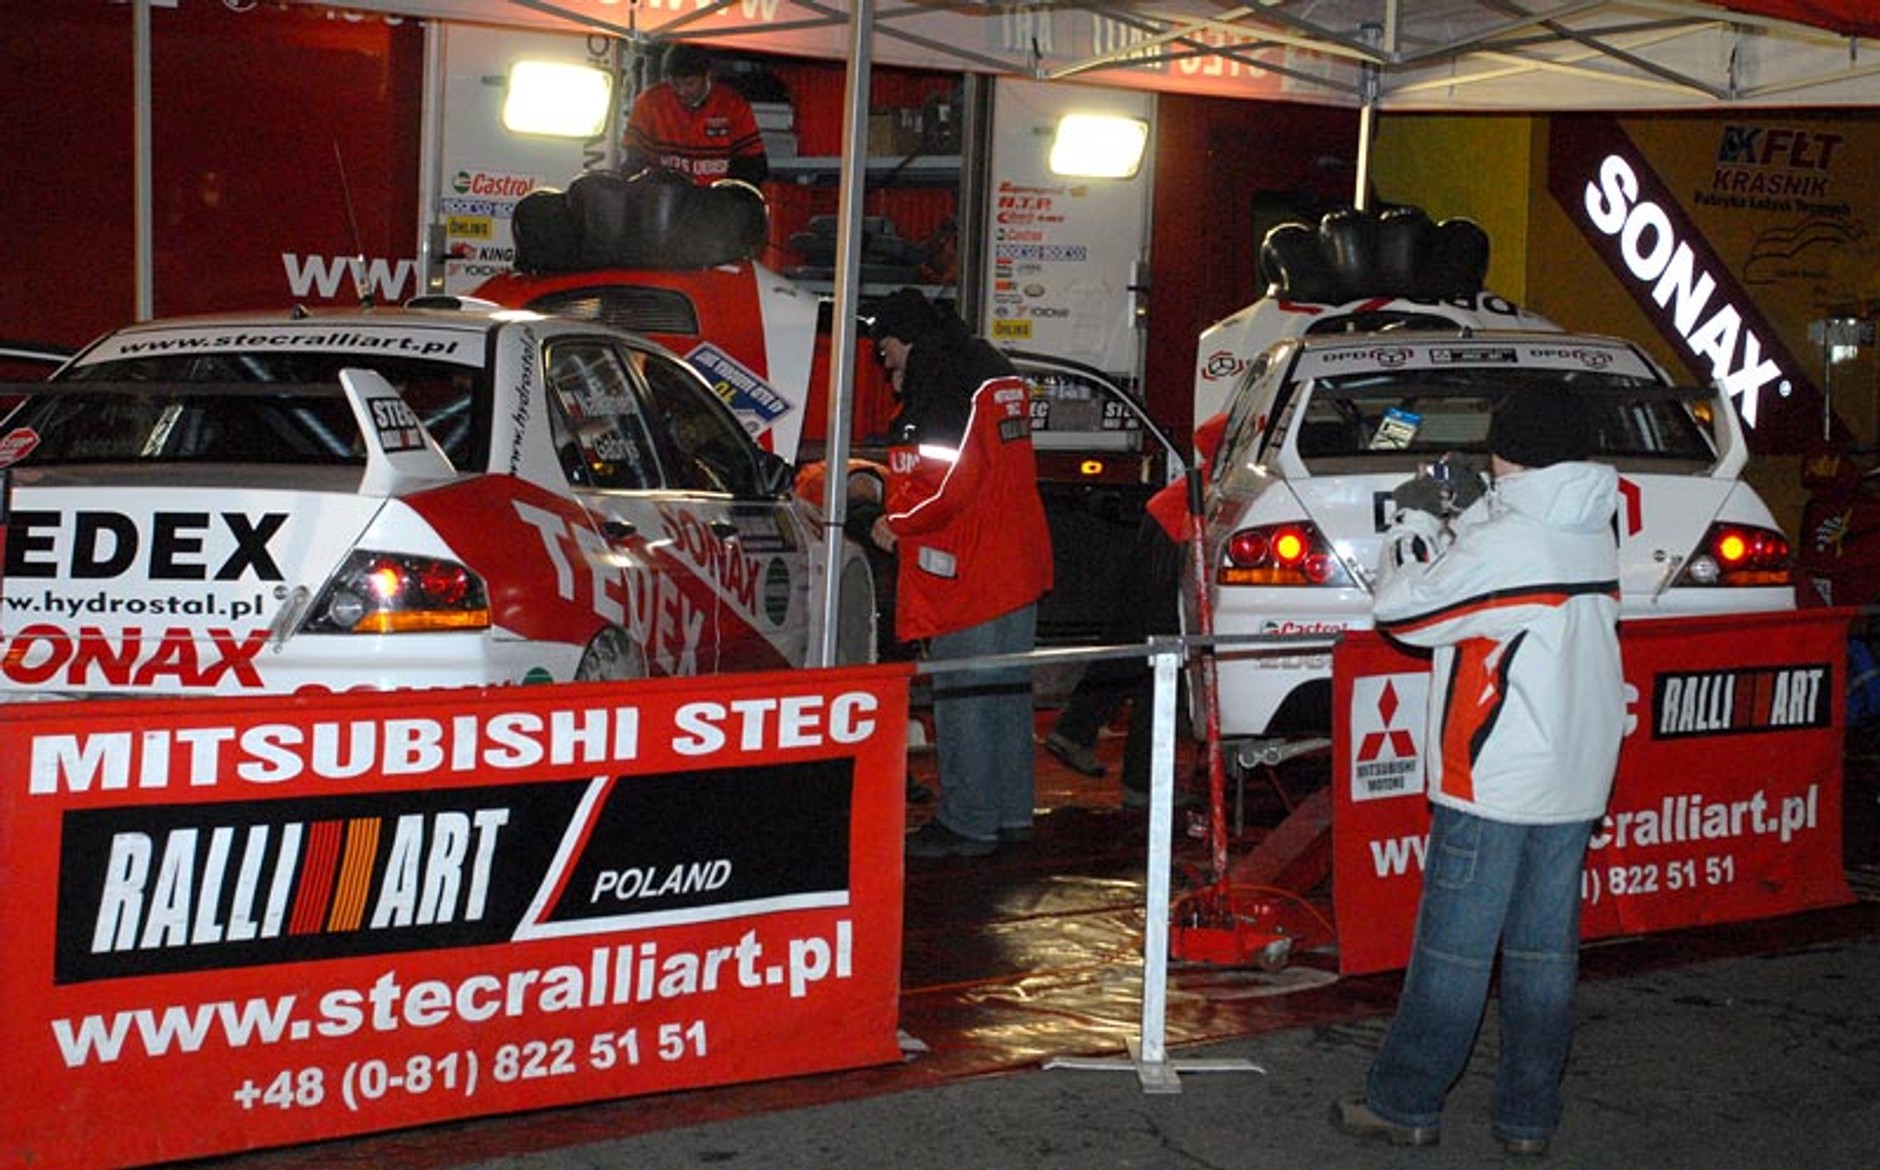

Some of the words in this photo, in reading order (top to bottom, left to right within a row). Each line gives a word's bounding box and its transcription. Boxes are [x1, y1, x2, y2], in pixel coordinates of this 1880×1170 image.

[1584, 154, 1783, 430] SONAX
[118, 332, 460, 355] www.stecralliart.pl
[0, 624, 274, 688] ONAX
[1660, 674, 1735, 734] RALLI
[1770, 668, 1823, 726] ART
[29, 707, 639, 795] MITSUBISHI
[672, 691, 878, 756] STEC
[91, 822, 303, 955] RALLI
[370, 808, 509, 929] ART
[591, 859, 732, 903] POLAND
[1608, 863, 1659, 895] 822
[1667, 859, 1697, 889] 51
[1706, 854, 1735, 885] 51
[51, 920, 853, 1069] www.stecralliart.pl
[234, 1068, 324, 1111] +48
[342, 1050, 478, 1111] (0-81)
[493, 1038, 576, 1083] 822
[590, 1028, 640, 1070] 51
[658, 1020, 708, 1061] 51
